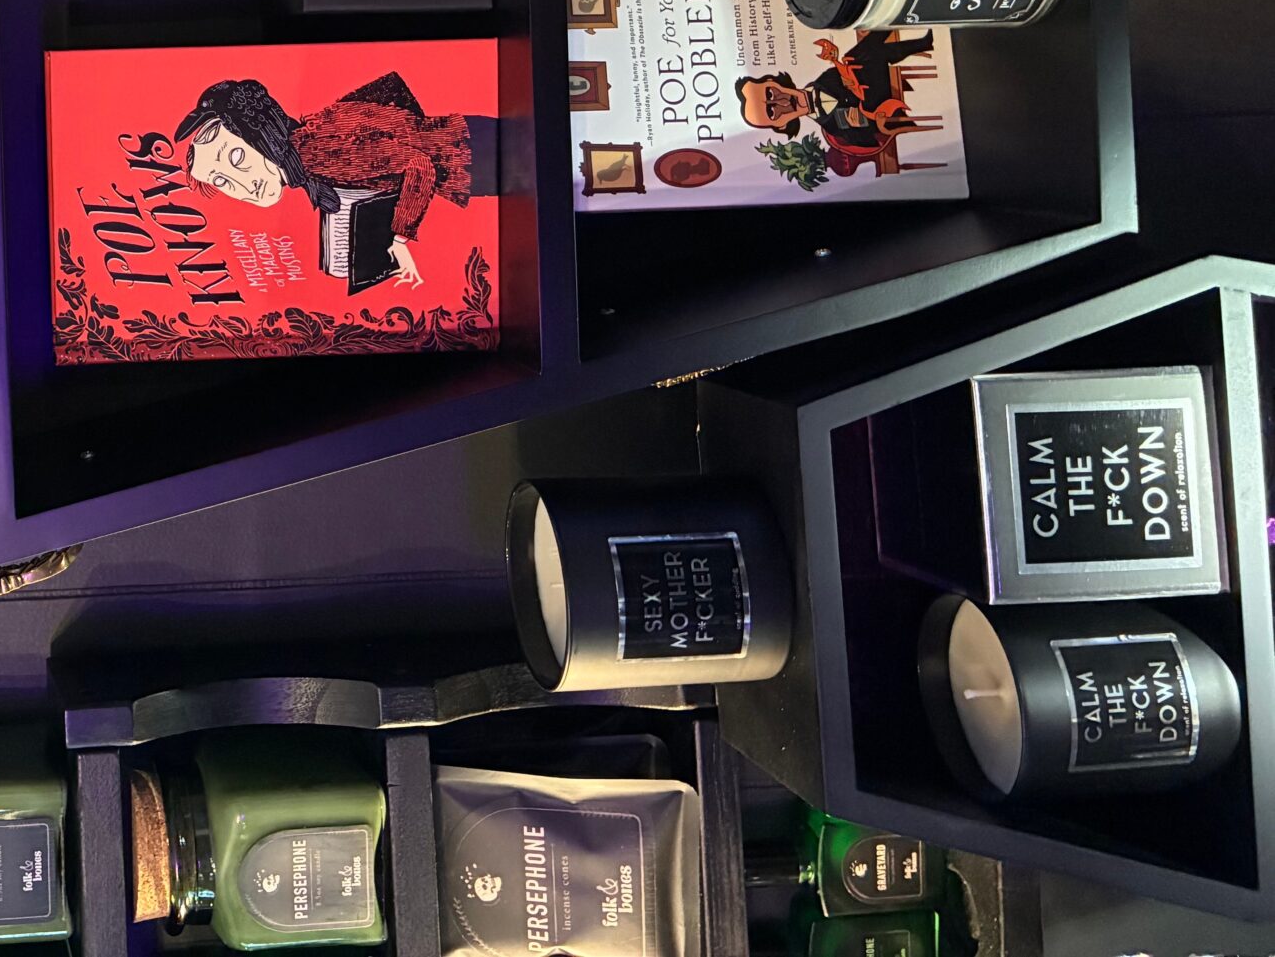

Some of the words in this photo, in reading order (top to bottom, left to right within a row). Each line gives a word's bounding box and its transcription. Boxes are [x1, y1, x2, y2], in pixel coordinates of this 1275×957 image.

[637, 15, 645, 44] Obstacle
[661, 17, 682, 48] for
[732, 4, 746, 67] Uncommon
[765, 34, 777, 66] Likely
[786, 19, 798, 66] CATHERINE
[632, 60, 640, 82] funny,
[640, 60, 647, 68] of
[752, 40, 761, 66] from
[642, 69, 650, 92] author
[656, 54, 689, 126] POE
[644, 93, 652, 122] Holiday,
[76, 182, 174, 289] POE
[117, 131, 246, 305] KNOWS
[228, 228, 268, 287] MISCELLANY
[249, 231, 284, 276] MACABRE
[271, 235, 308, 281] MUSINGS
[1173, 432, 1186, 486] relaxation
[1027, 436, 1060, 539] CALM
[1065, 455, 1096, 517] THE
[1137, 425, 1171, 541] DOWN
[1175, 488, 1187, 501] of
[1177, 504, 1189, 532] scent
[640, 573, 663, 632] SEXY
[663, 550, 690, 649] MOTHER
[1076, 671, 1103, 743] CALM
[1104, 683, 1127, 728] THE
[1148, 660, 1178, 743] DOWN
[1175, 665, 1189, 704] relaxation
[1182, 705, 1190, 714] of
[22, 871, 34, 892] folk
[31, 850, 43, 882] bones
[292, 839, 309, 920] PERSEPHONE
[341, 876, 352, 897] folk
[351, 856, 362, 887] bones
[559, 854, 570, 886] cones
[876, 844, 887, 891] GRAVEYARD
[522, 825, 550, 953] PERSEPHONE
[561, 890, 572, 931] incense
[619, 865, 634, 913] bones
[602, 897, 619, 927] folk
